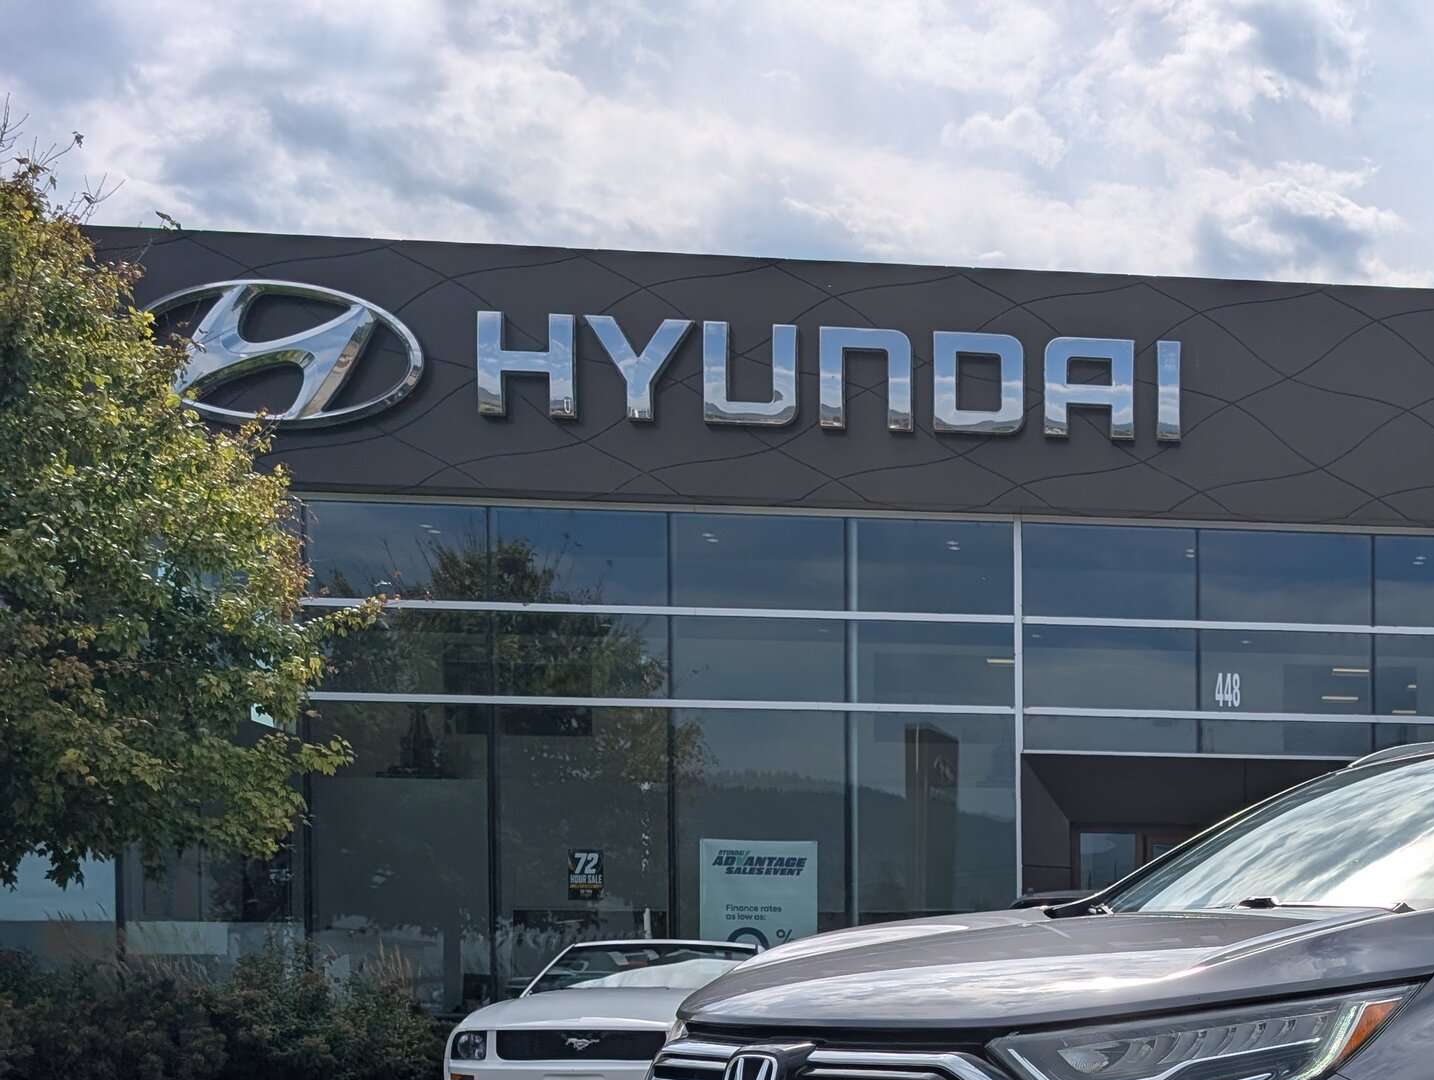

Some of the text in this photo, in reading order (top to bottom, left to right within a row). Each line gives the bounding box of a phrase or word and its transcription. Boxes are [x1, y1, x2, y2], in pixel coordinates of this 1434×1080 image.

[477, 310, 1181, 441] HYUNDAI
[1215, 672, 1240, 707] 448
[574, 852, 599, 874] 72
[712, 855, 807, 868] ADVANTAGE
[725, 867, 803, 876] SALES EVENT
[570, 874, 602, 884] HOUR SALE
[726, 904, 782, 913] Finance rates
[737, 912, 753, 921] low
